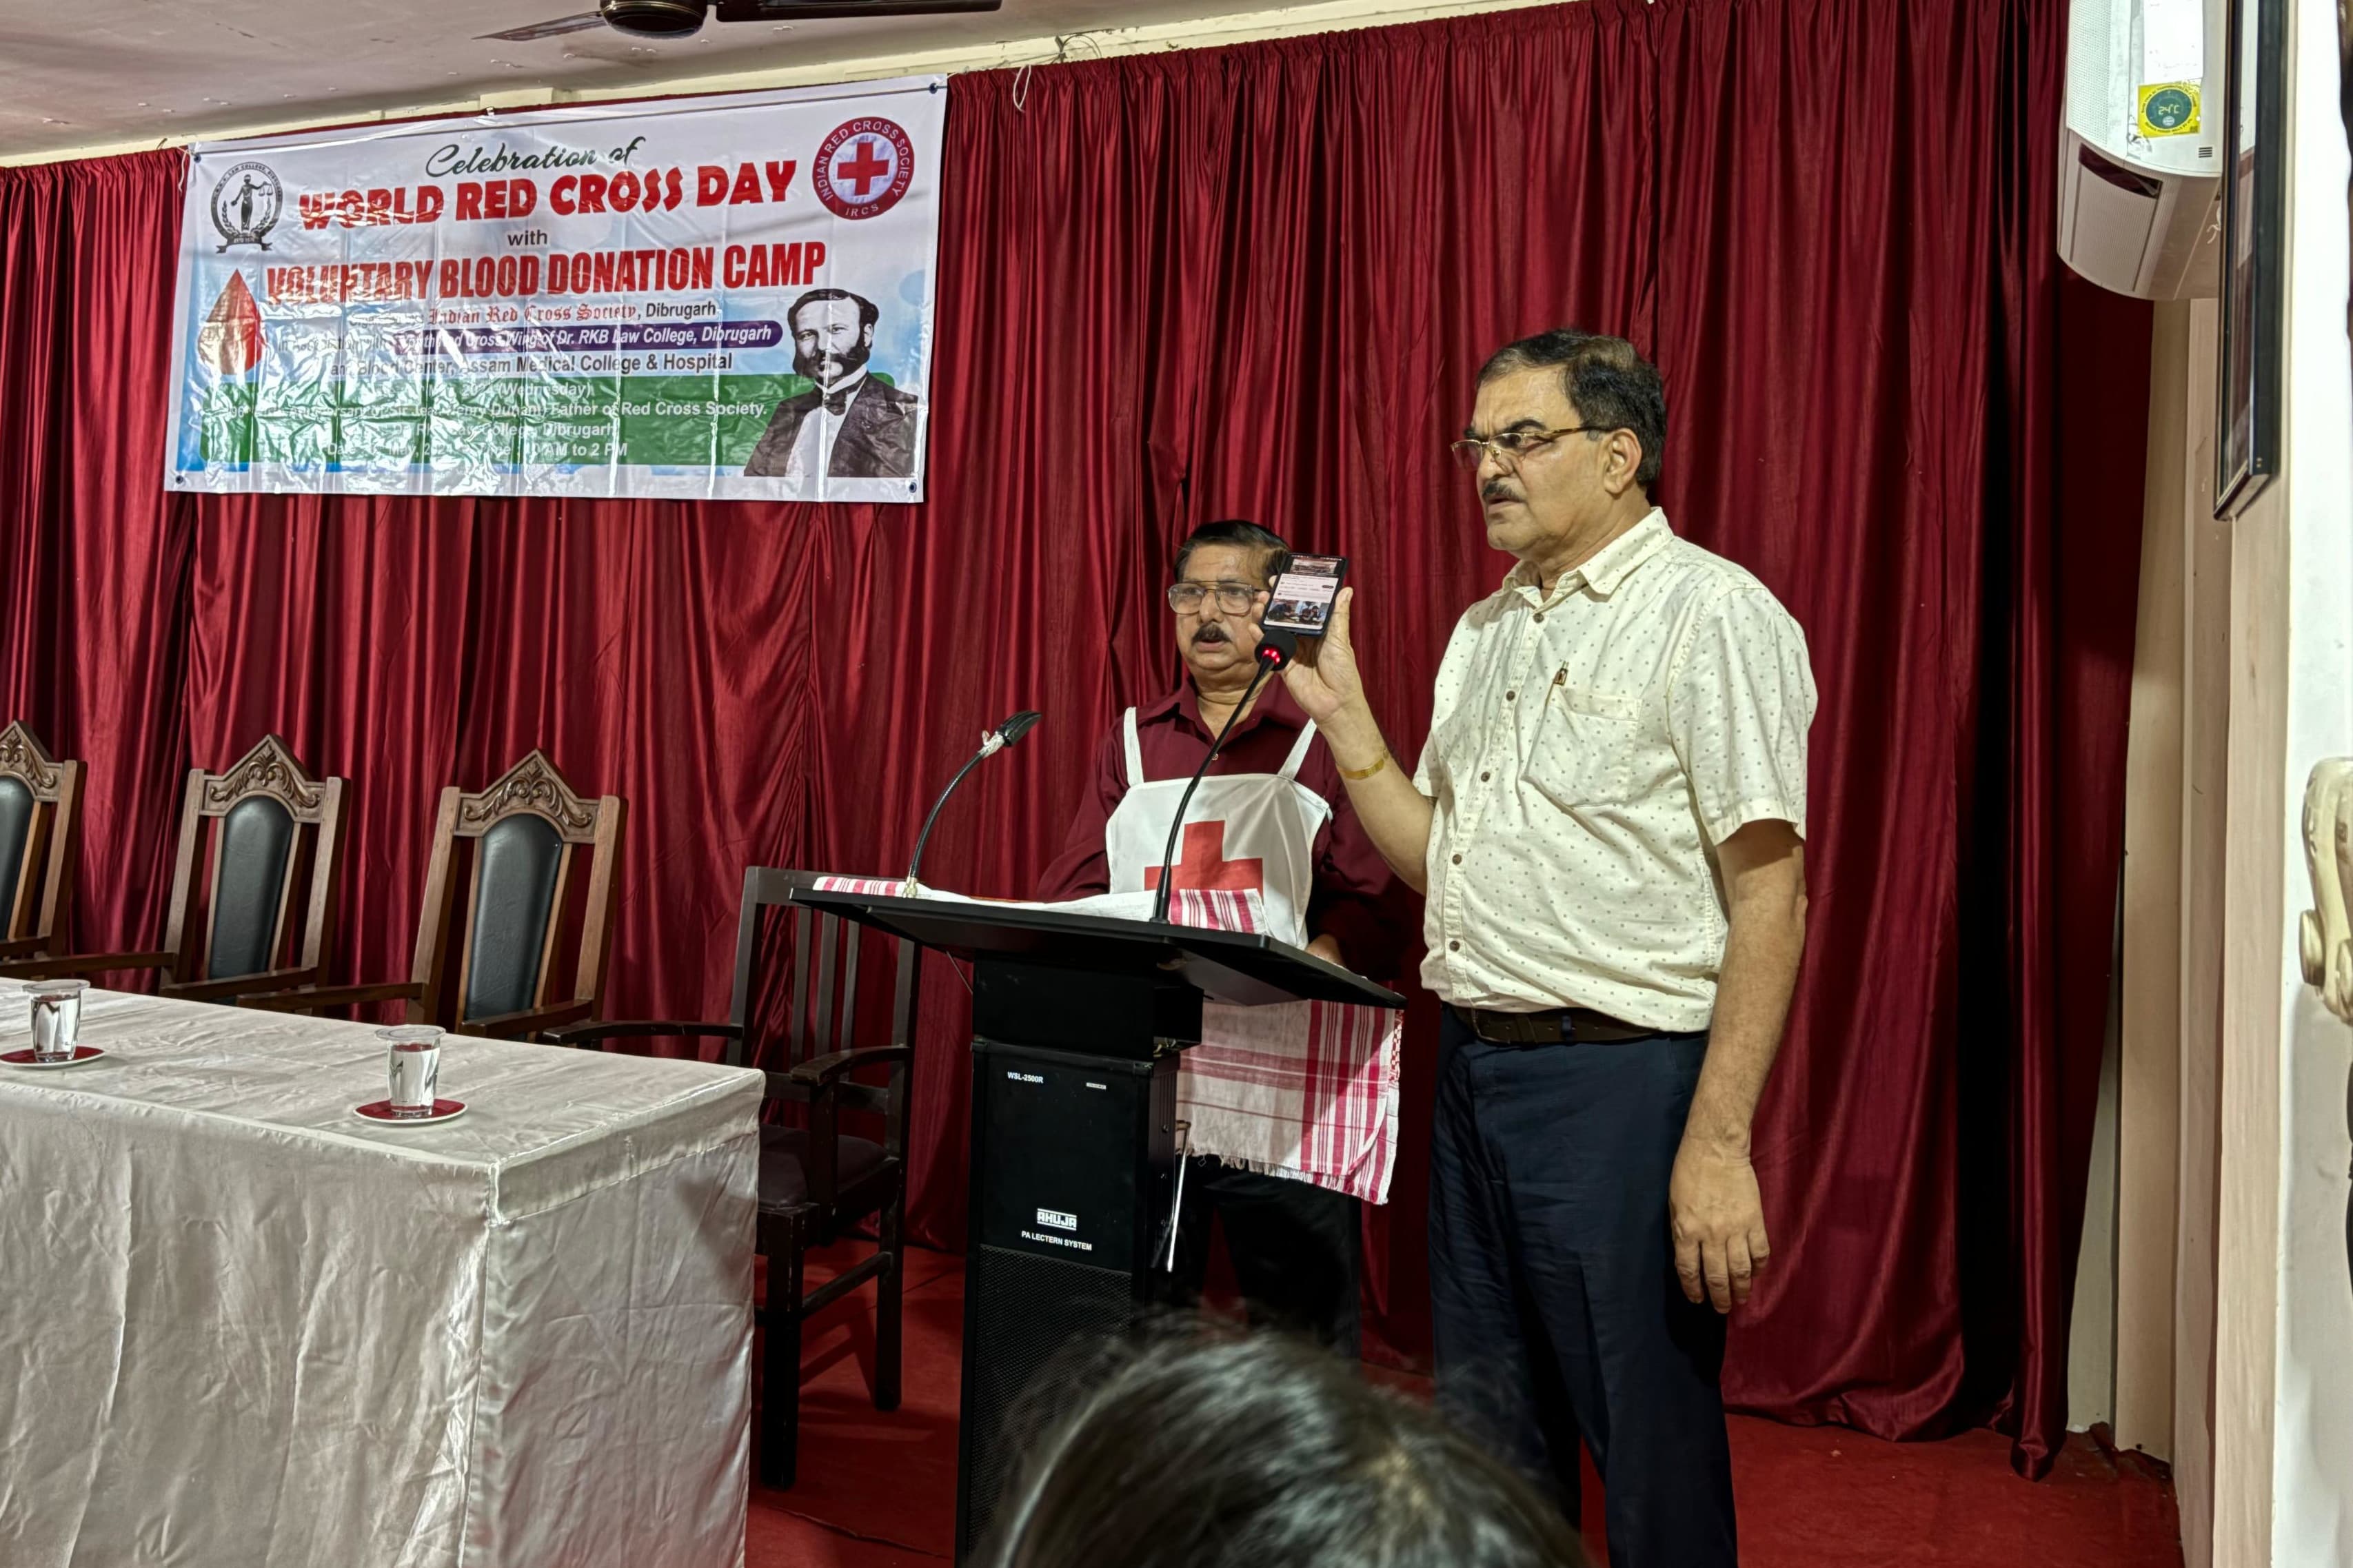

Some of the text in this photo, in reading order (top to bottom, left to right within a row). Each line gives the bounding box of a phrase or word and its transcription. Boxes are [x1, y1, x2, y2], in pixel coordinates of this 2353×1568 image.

[425, 136, 646, 177] Celebration of
[816, 121, 911, 201] INDIAN RED CROSS SOCIETY
[299, 185, 444, 230] WORLD
[456, 178, 537, 221] RED
[549, 165, 685, 216] CROSS
[696, 159, 797, 207] DAY
[845, 203, 879, 217] IRCS
[507, 229, 547, 246] with
[266, 241, 826, 305] VOLUNTARY BLOOD DONATION CAMP
[429, 307, 480, 325] Indian
[485, 305, 518, 323] Red
[525, 305, 572, 321] Cross
[646, 301, 716, 319] Dibrugarh
[465, 334, 498, 347] Cross
[557, 331, 574, 344] Dr.
[578, 329, 609, 345] RKB
[612, 328, 640, 344] Law
[643, 327, 697, 345] College,
[701, 325, 771, 345] Dibrugarh
[331, 362, 354, 376] an
[516, 354, 574, 373] Medical
[580, 354, 641, 374] College
[646, 353, 658, 370] &
[663, 352, 732, 373] Hospital
[447, 405, 487, 419] enry
[551, 402, 598, 416] Father
[622, 401, 651, 416] Red
[655, 401, 700, 416] Cross
[705, 400, 767, 418] Society.
[572, 443, 587, 456] to
[590, 442, 600, 456] 2
[1007, 1071, 1044, 1083] WSL-2500R
[1037, 1210, 1077, 1228] AHUJA
[1021, 1230, 1092, 1251] PA LECTERN SYSTEM
